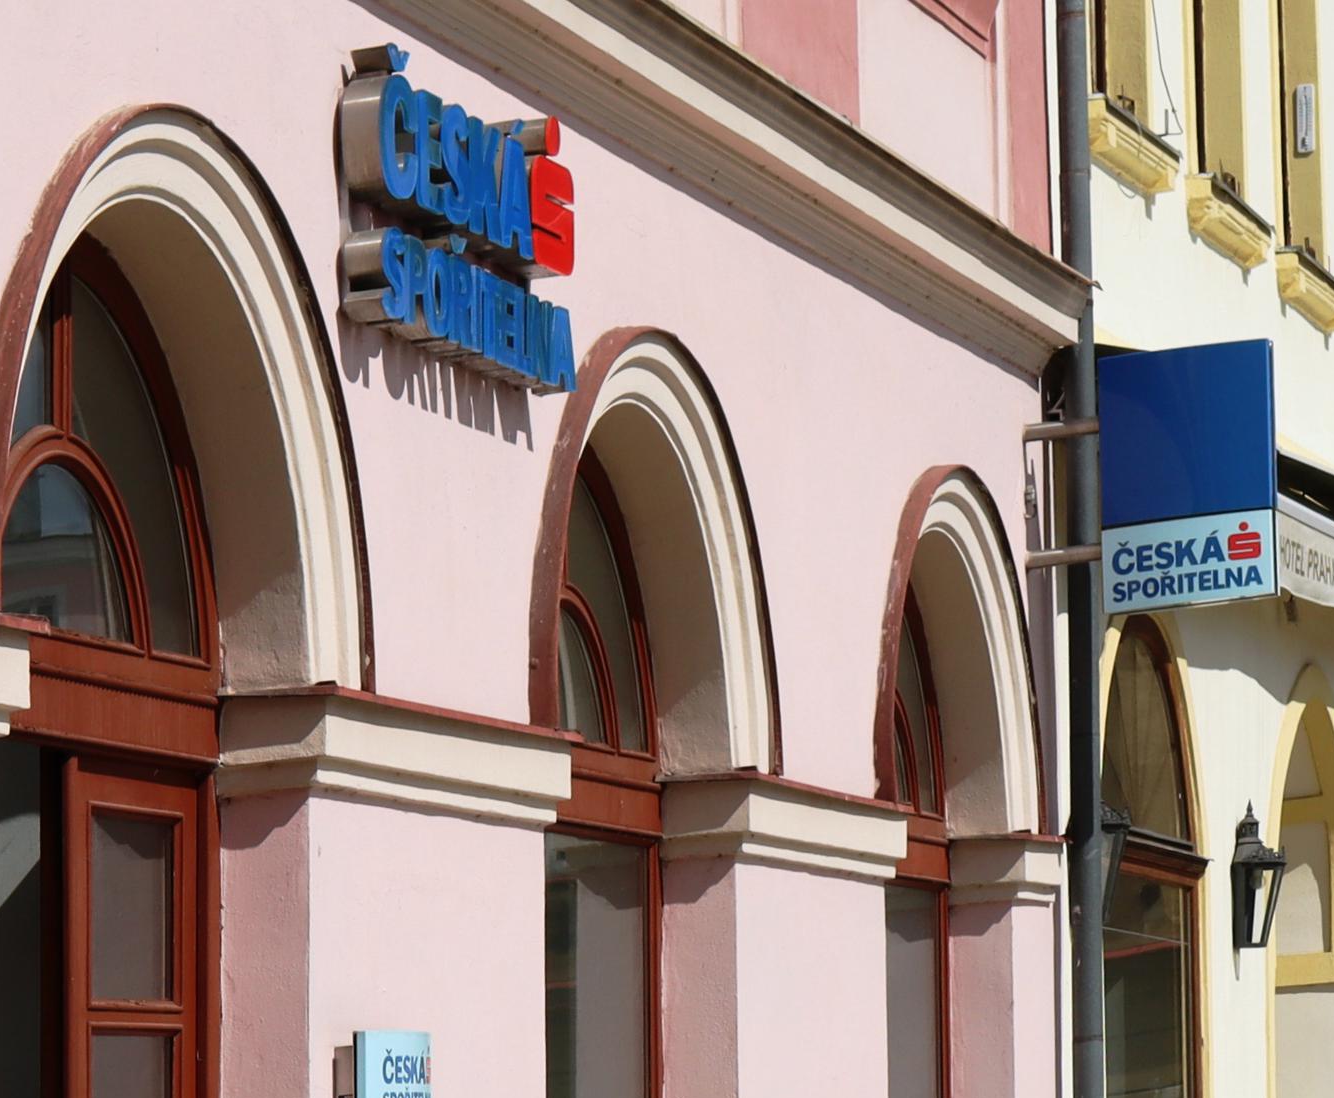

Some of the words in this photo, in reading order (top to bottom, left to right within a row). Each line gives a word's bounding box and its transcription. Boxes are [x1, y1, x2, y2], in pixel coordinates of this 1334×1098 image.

[379, 43, 533, 260] ČESKÁ
[381, 226, 577, 392] SPOŘITELNA
[1112, 529, 1226, 576] ČESKÁ
[1279, 536, 1305, 578] HOTEL
[1112, 565, 1263, 604] SPOŘITELNA
[382, 1048, 426, 1085] ČESKÁ
